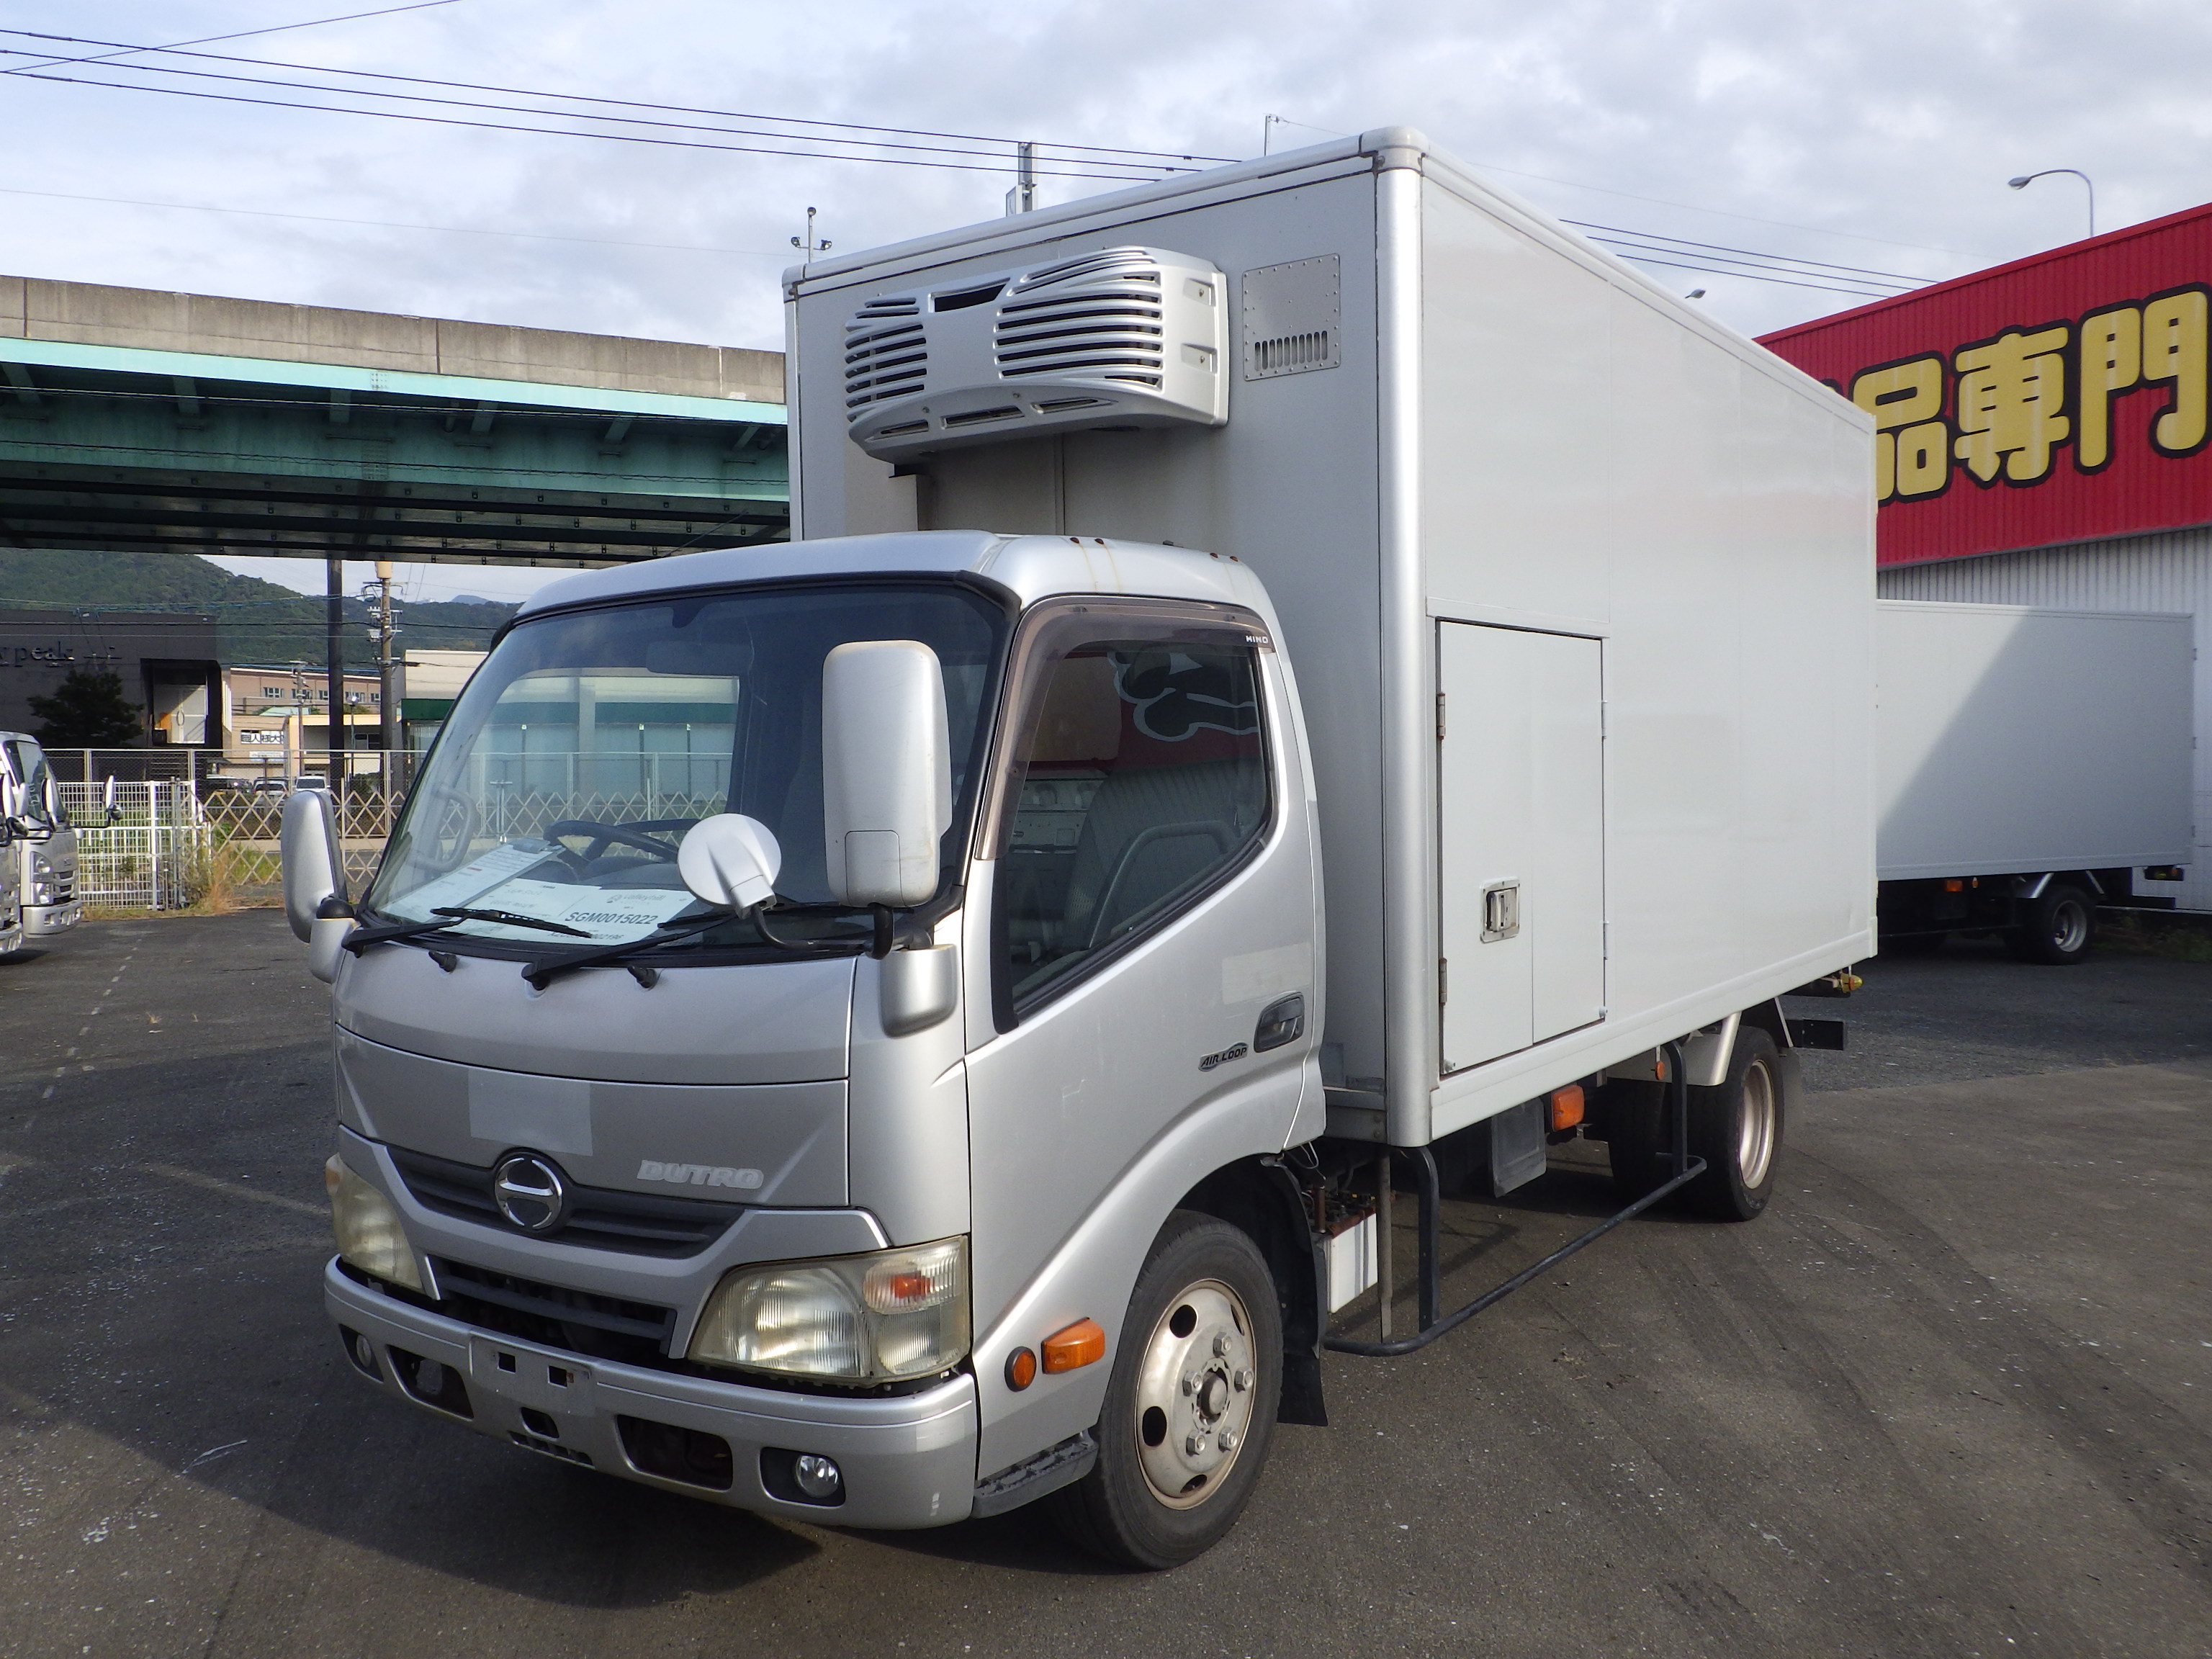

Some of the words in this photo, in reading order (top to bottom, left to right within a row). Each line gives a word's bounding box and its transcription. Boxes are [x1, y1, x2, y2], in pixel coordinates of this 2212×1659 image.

[1823, 283, 2211, 505] 品専門
[1246, 635, 1269, 644] HINO
[565, 912, 658, 925] SGM0015022
[1200, 1054, 1219, 1067] AIR
[1221, 1047, 1247, 1061] LOOP
[637, 1159, 765, 1190] DUTRO
